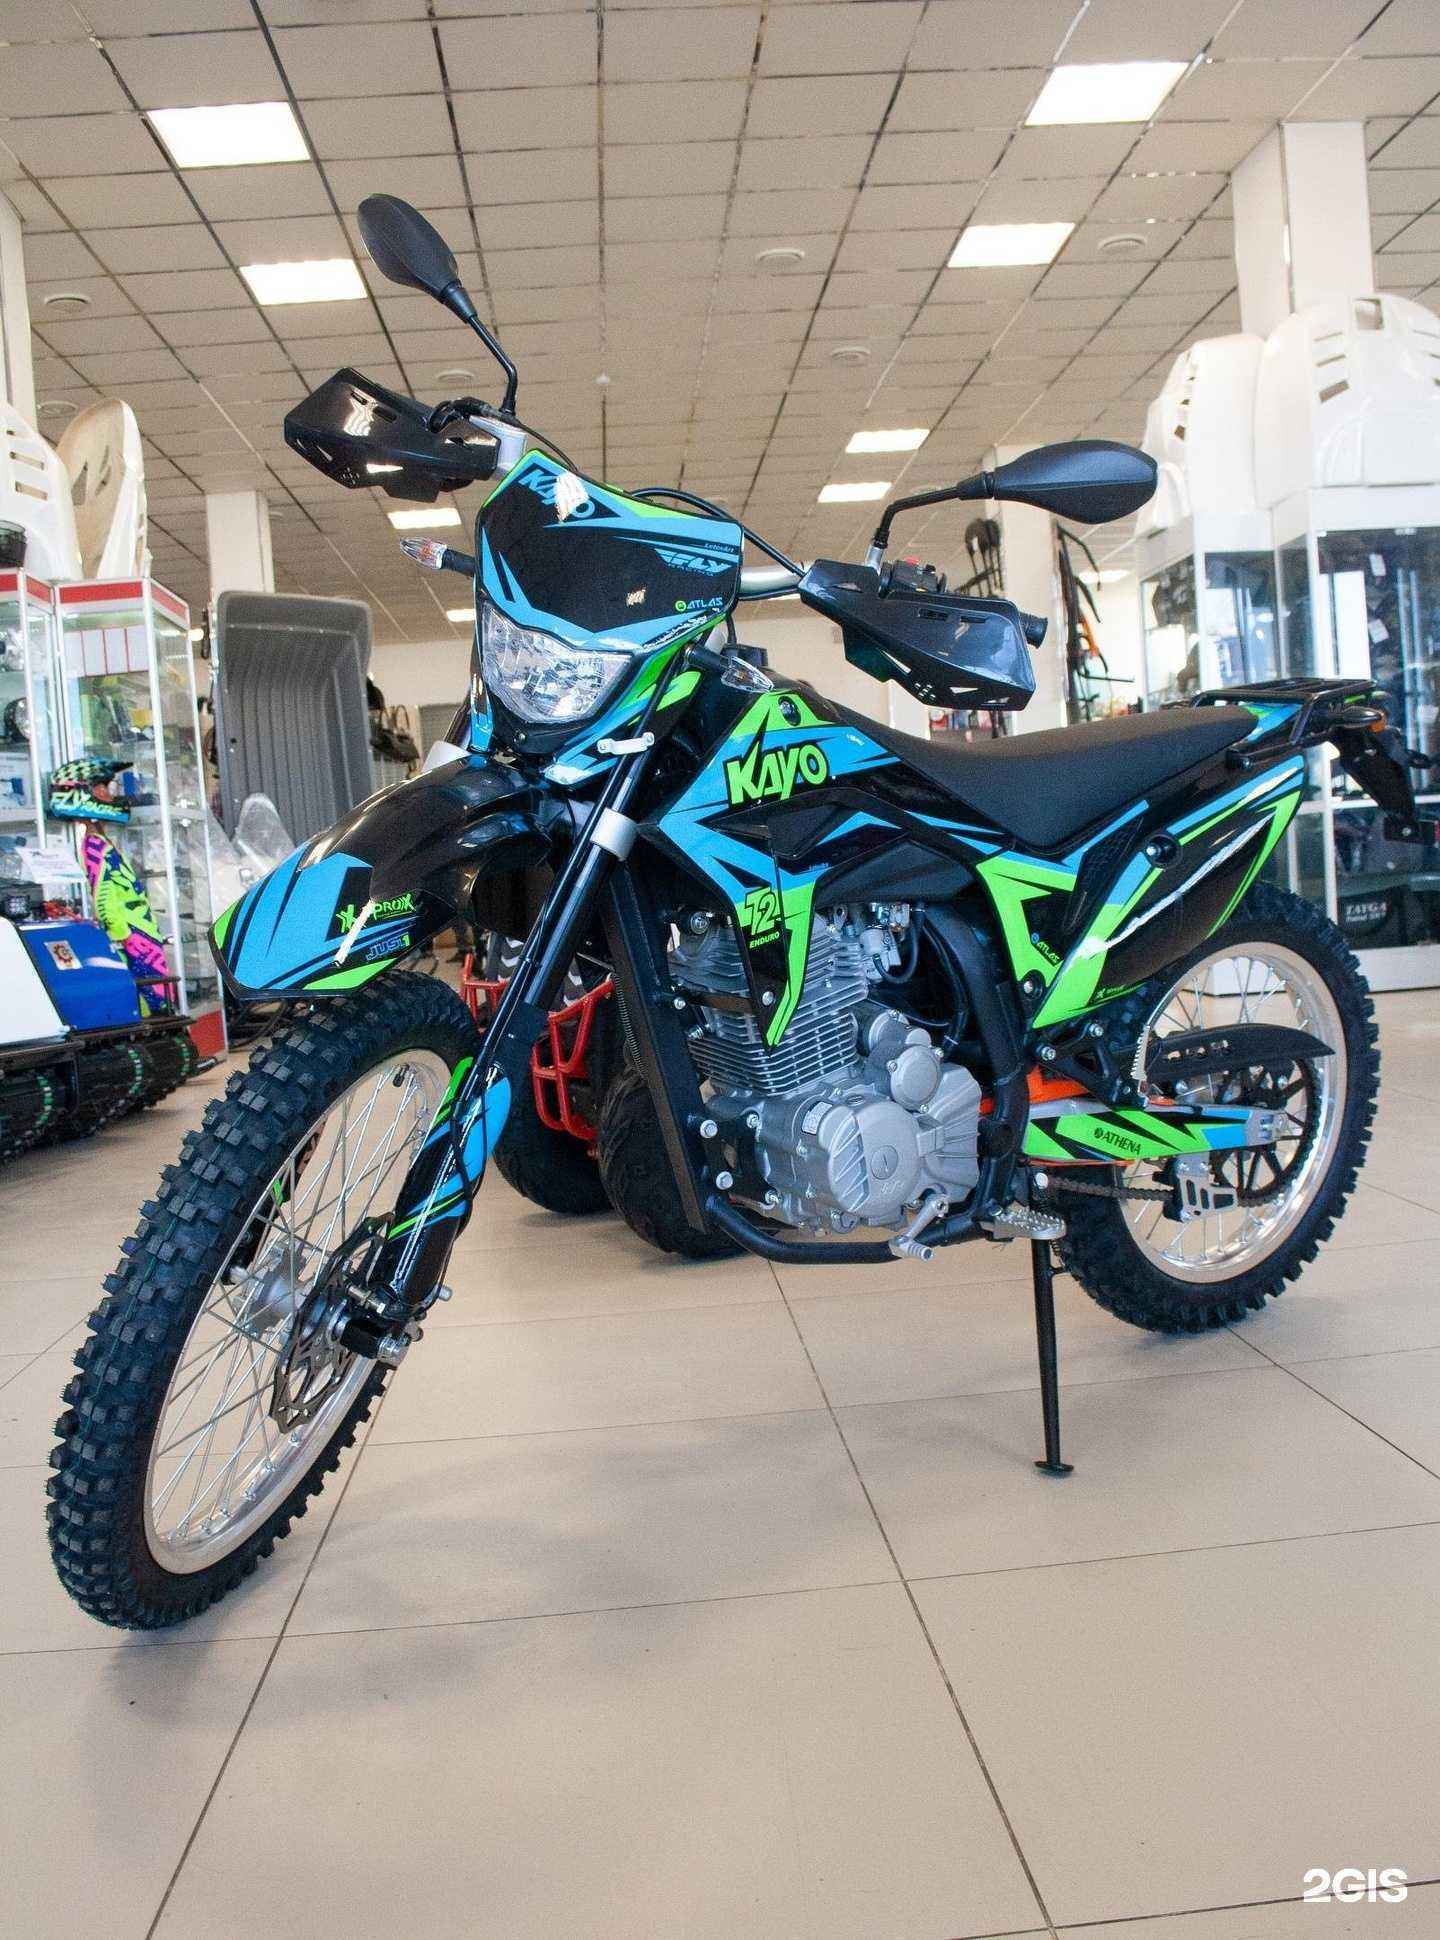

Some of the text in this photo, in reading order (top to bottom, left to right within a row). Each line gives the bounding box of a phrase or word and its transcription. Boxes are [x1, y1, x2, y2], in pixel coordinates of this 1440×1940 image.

[518, 468, 596, 519] KAO
[687, 597, 723, 610] ATLAS
[726, 741, 828, 805] KAYO
[749, 931, 780, 950] ENDURO
[1100, 1130, 1142, 1156] ATHENA
